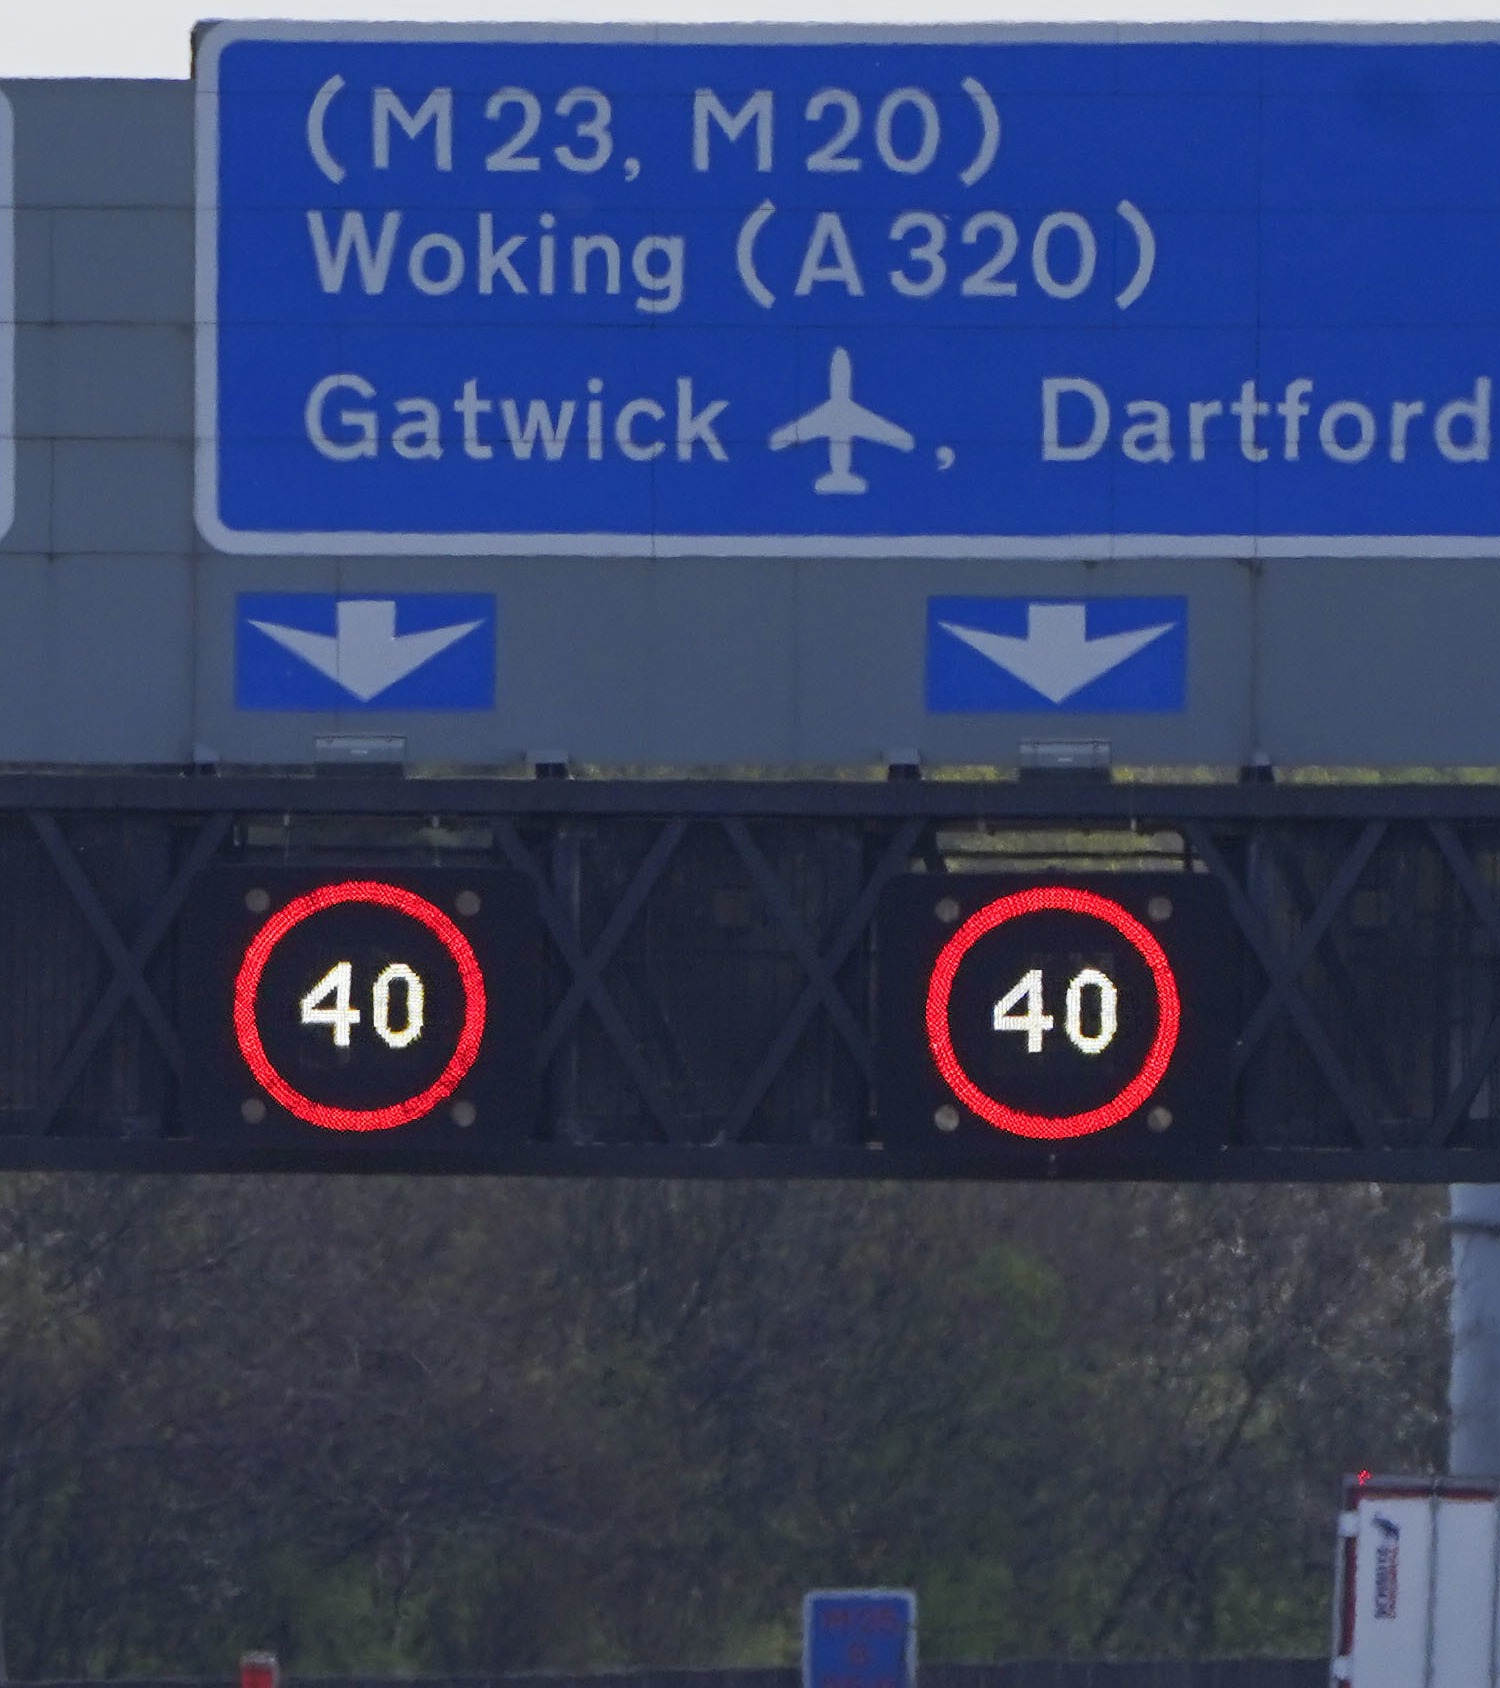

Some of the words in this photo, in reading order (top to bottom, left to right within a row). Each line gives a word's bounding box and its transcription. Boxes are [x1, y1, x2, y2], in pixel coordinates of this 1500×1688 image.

[307, 210, 684, 313] Woking
[305, 374, 728, 461] Gatwick
[1042, 376, 1491, 463] Dartford
[301, 963, 423, 1048] 40
[993, 969, 1117, 1053] 40
